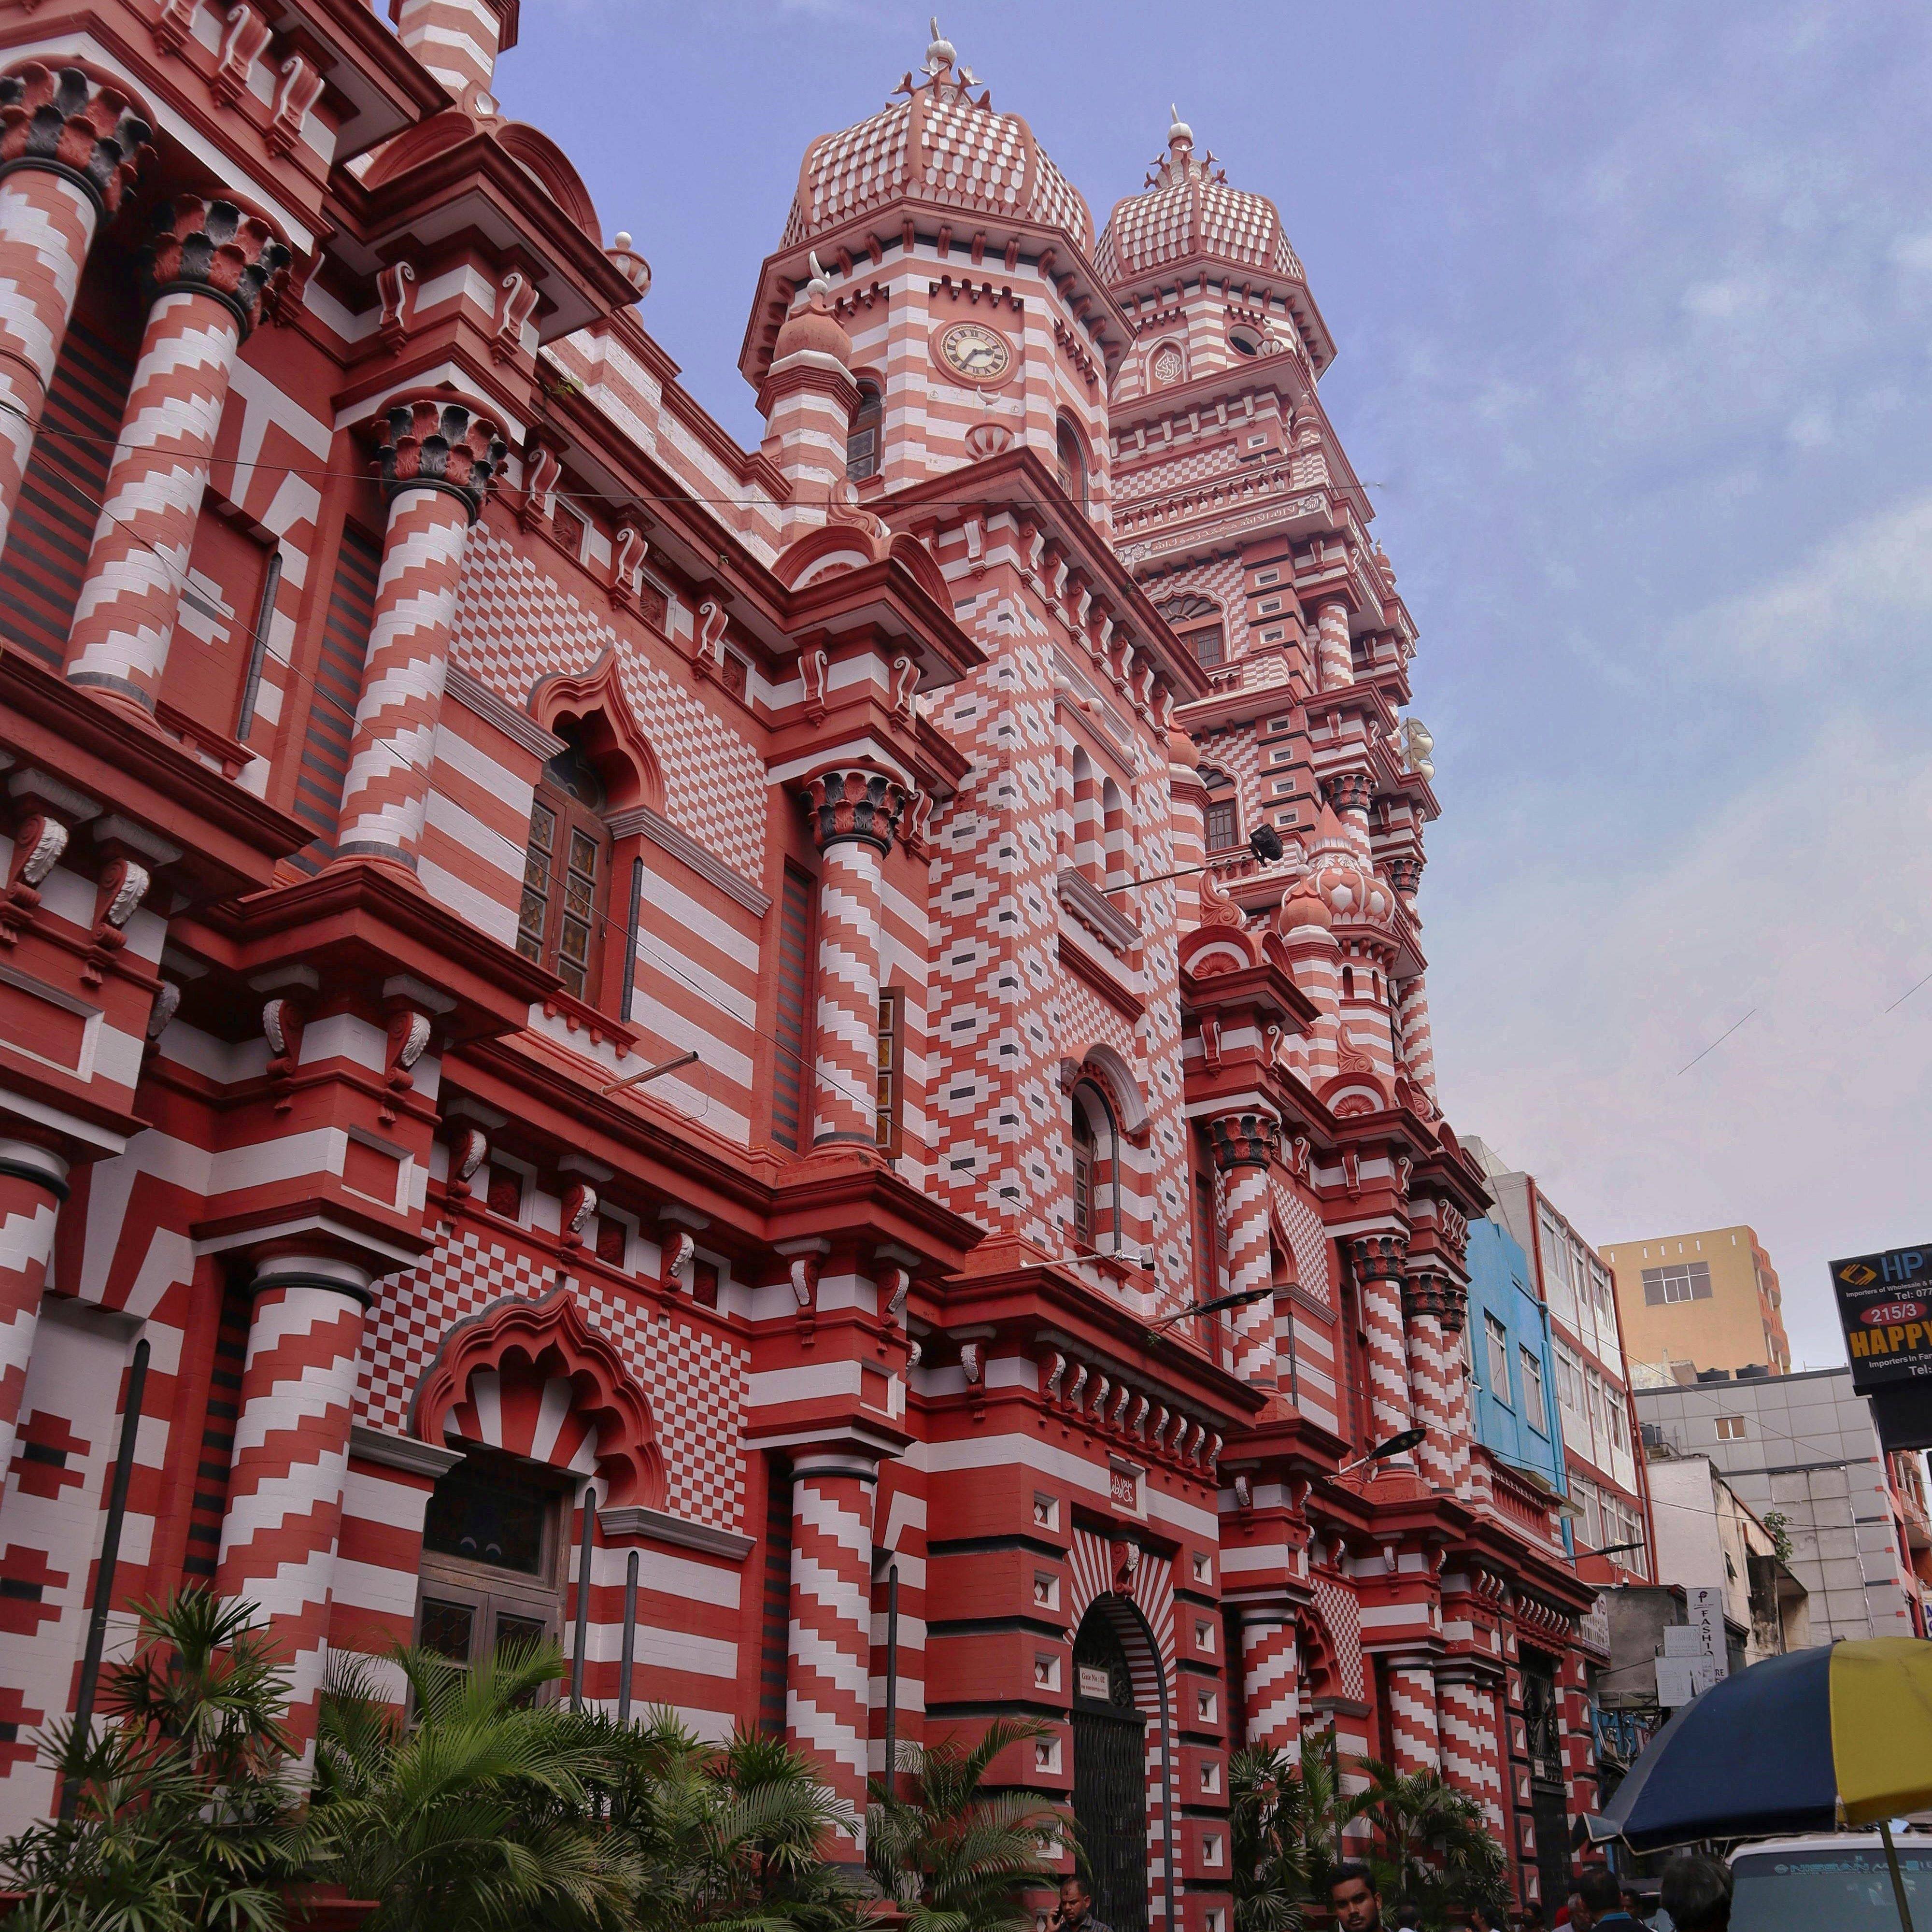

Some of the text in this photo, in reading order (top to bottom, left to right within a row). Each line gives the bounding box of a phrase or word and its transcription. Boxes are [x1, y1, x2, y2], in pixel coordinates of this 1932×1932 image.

[1881, 1251, 1924, 1282] HP
[1846, 1289, 1878, 1298] Importers
[1887, 1282, 1921, 1291] Wholesale
[1894, 1291, 1914, 1300] Tel:
[1871, 1303, 1917, 1322] 215/3
[1869, 1357, 1908, 1368] Importers
[1908, 1364, 1932, 1376] Tel:
[1081, 1672, 1091, 1680] Gate
